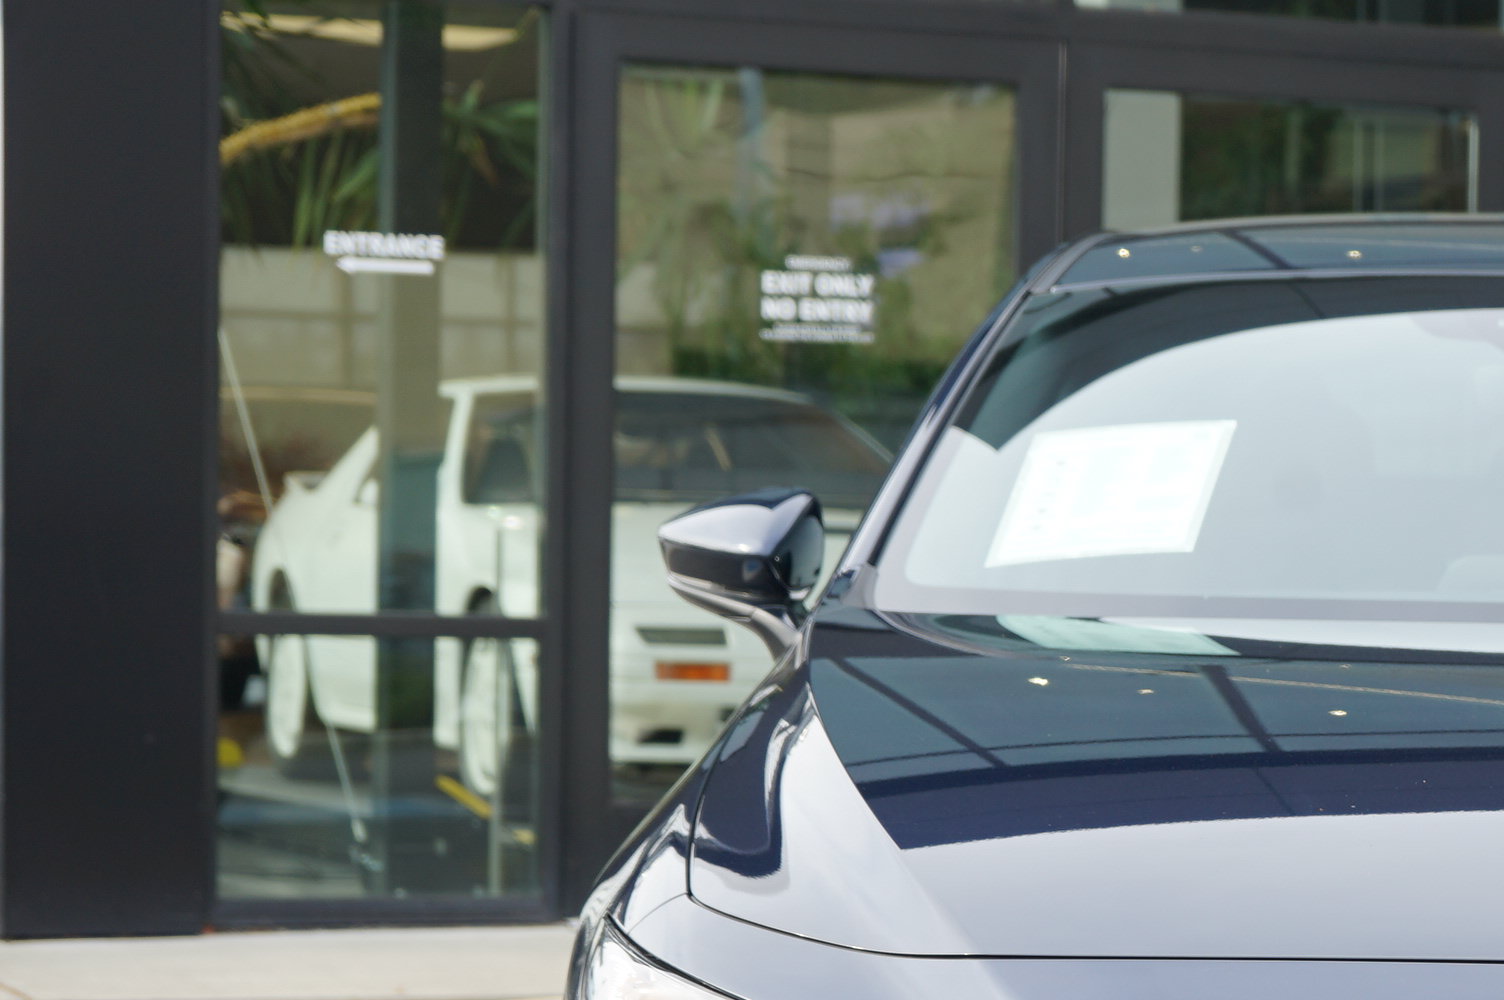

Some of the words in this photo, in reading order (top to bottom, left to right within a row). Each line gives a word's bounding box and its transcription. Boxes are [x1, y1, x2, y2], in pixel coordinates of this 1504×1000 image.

[322, 229, 446, 260] ENTRANCE
[760, 269, 813, 296] EXIT
[814, 271, 875, 298] ONLY
[760, 296, 797, 321] NO
[798, 297, 875, 324] ENTRY
